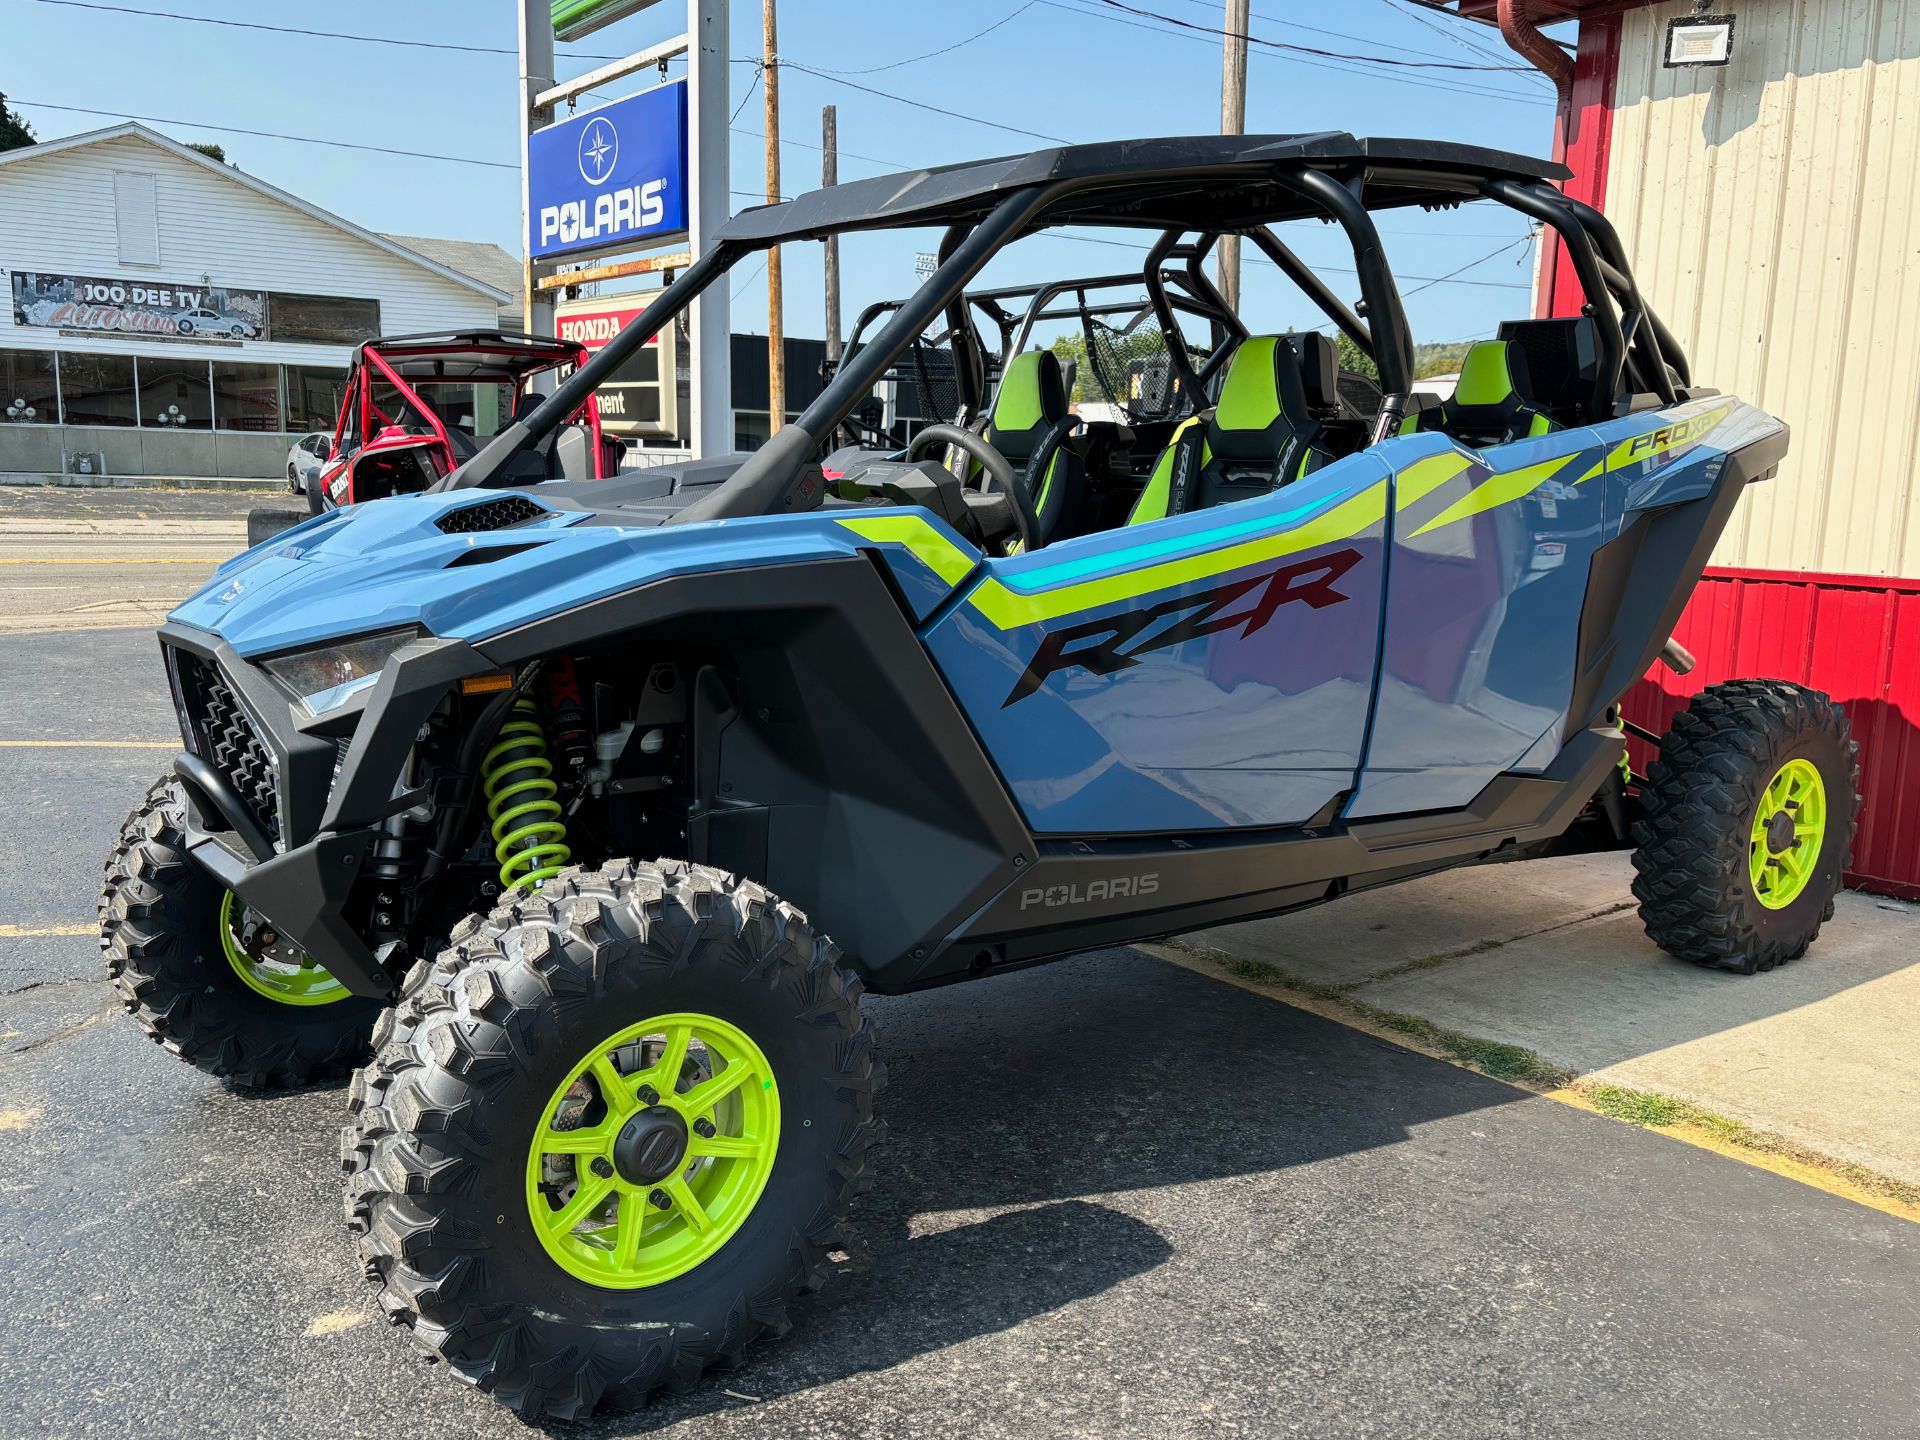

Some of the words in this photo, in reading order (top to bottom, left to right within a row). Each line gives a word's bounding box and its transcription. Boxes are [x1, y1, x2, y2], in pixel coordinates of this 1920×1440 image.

[132, 288, 172, 307] DEE
[176, 291, 202, 309] TV
[561, 317, 620, 342] HONDA
[1000, 548, 1364, 710] RZR
[1020, 873, 1159, 910] POLARIS
